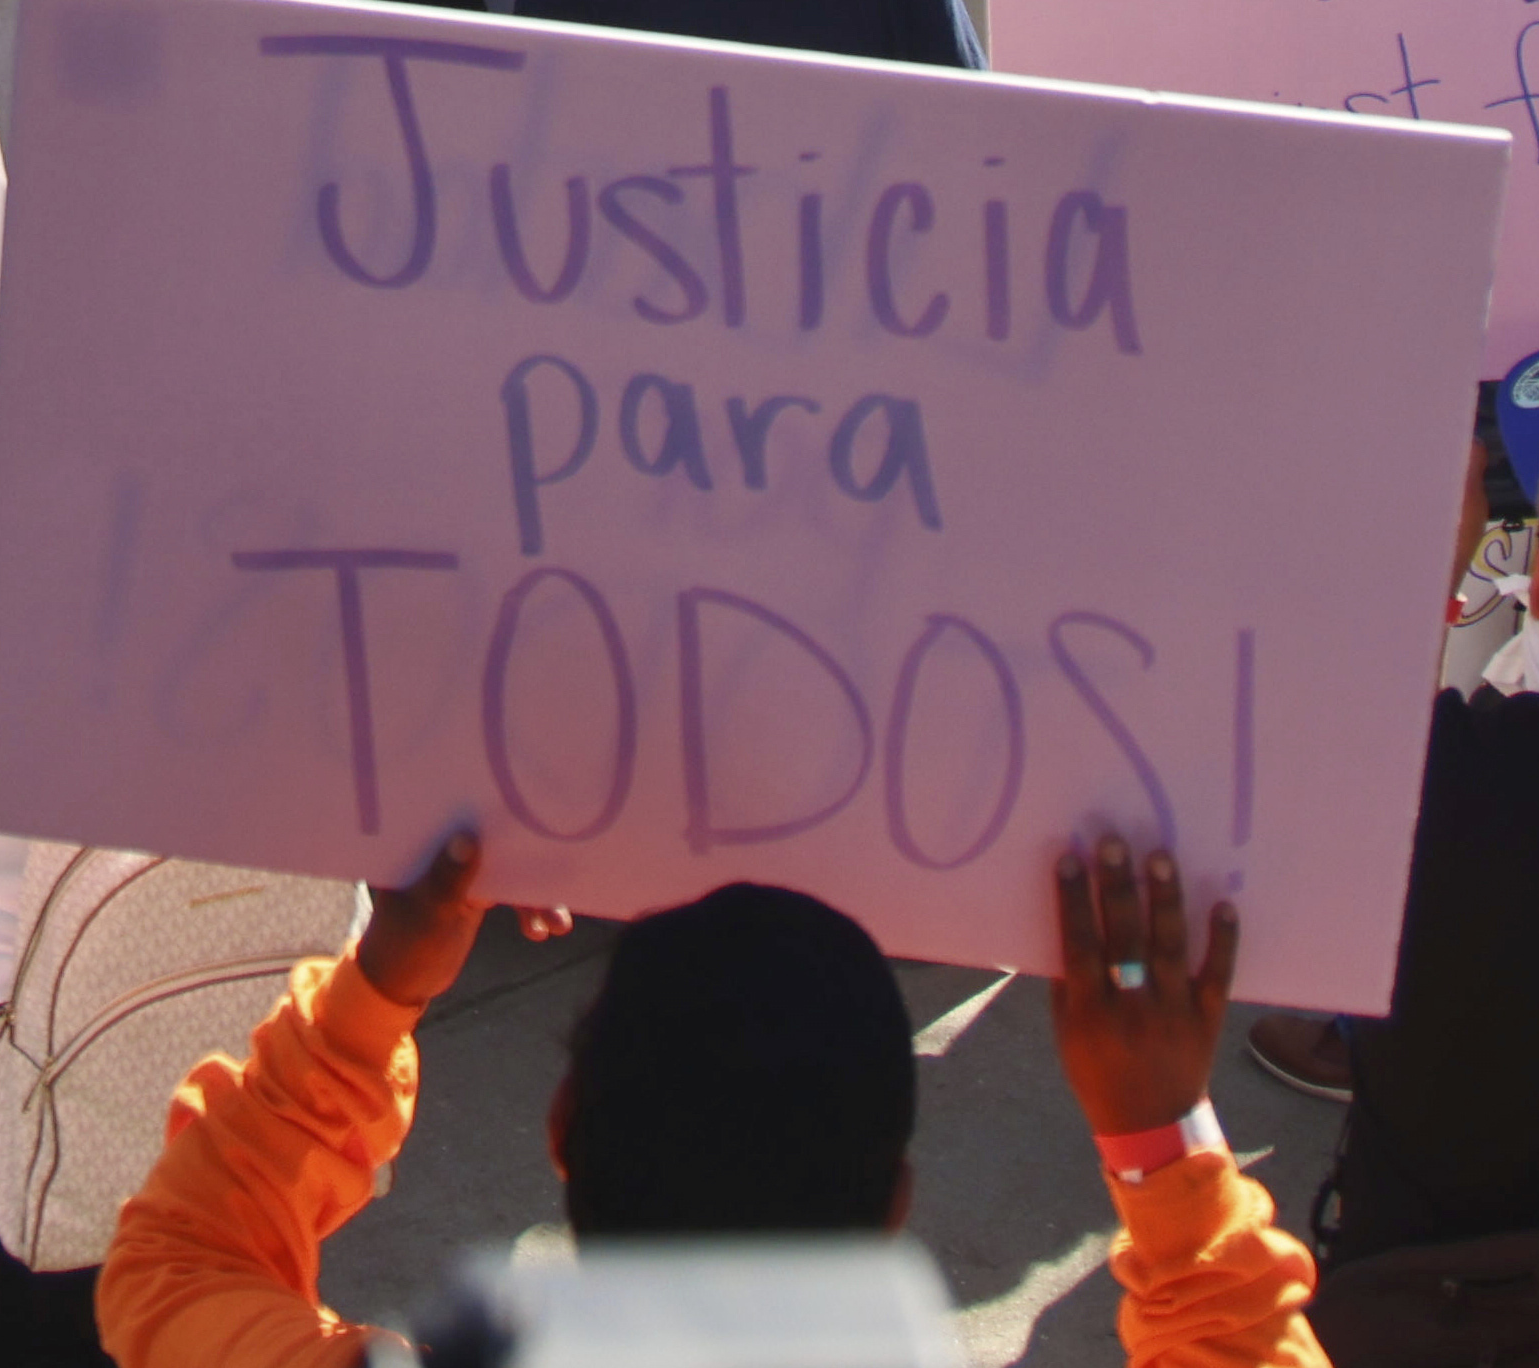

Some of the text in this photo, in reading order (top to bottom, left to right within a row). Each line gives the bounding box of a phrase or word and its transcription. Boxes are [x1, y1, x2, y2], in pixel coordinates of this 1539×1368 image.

[259, 35, 1143, 355] Justicia
[500, 353, 944, 556] para
[231, 549, 1258, 892] TODOS!
